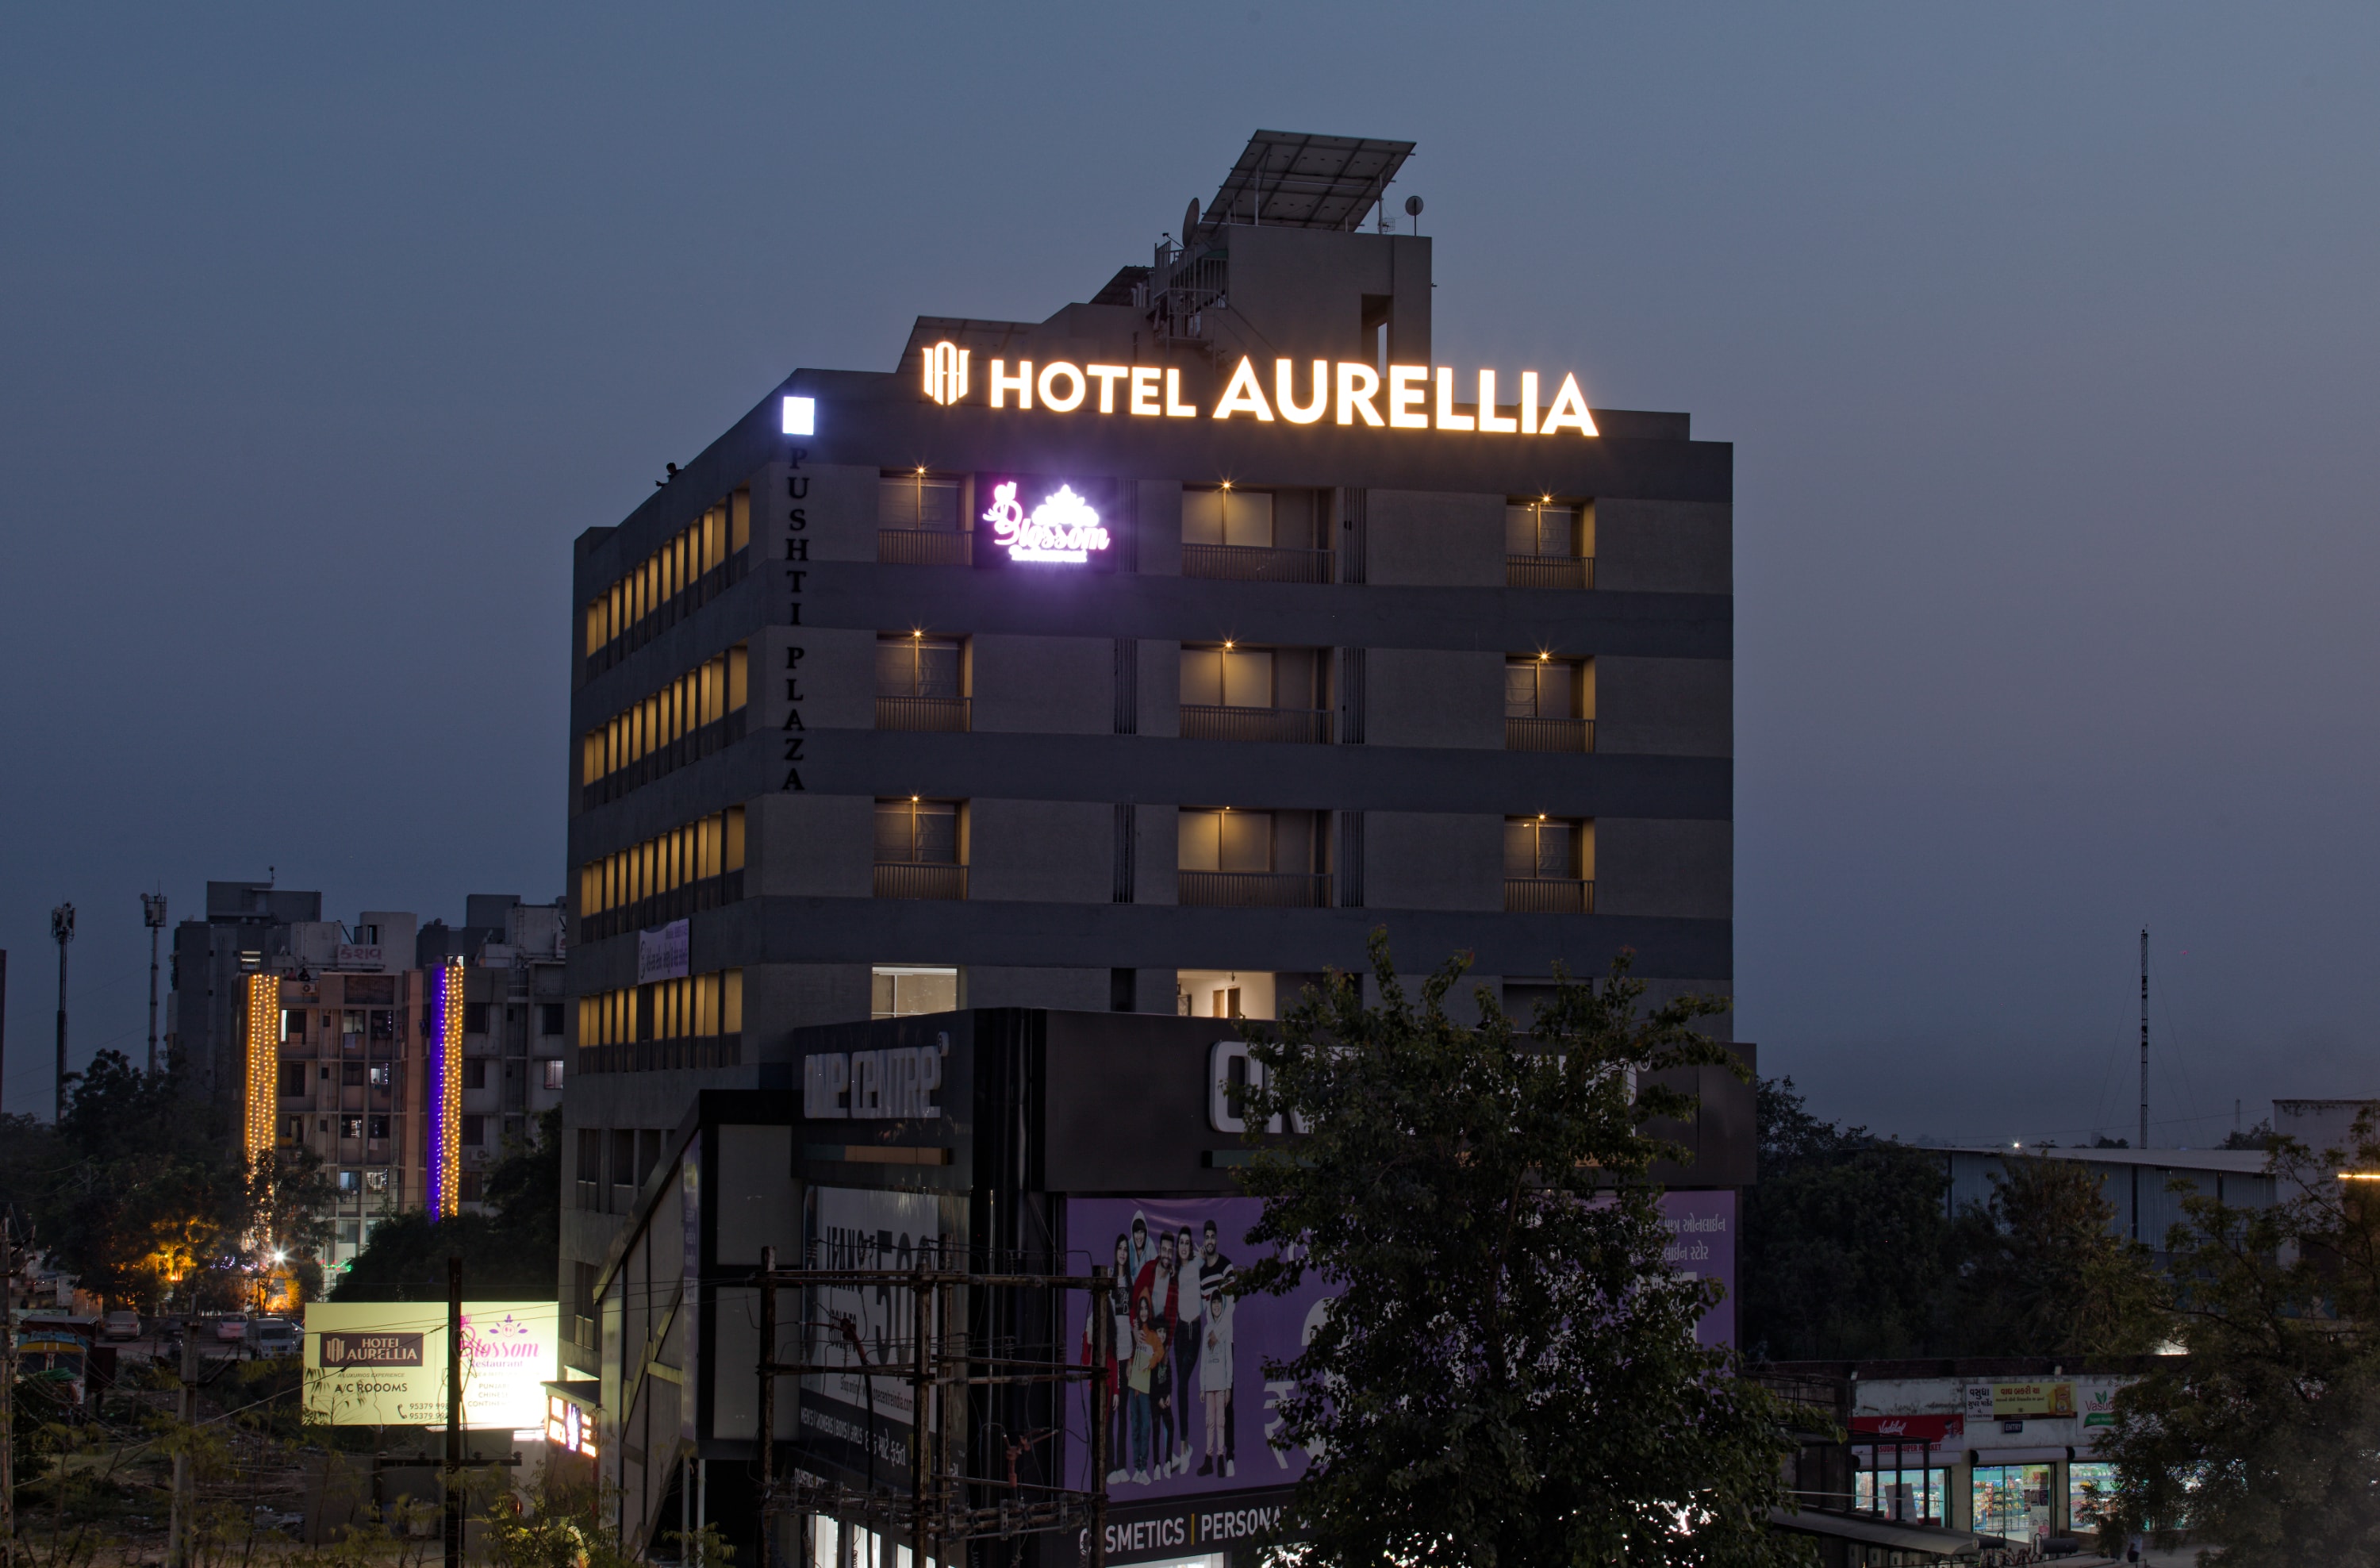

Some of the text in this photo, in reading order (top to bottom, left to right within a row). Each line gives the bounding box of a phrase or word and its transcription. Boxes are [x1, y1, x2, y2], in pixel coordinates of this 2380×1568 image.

[990, 353, 1600, 437] HOTEL AURELLIA
[982, 481, 1111, 551] Blossom
[781, 447, 810, 791] PUSHTI PLAZA
[804, 1052, 850, 1120] ONE
[1690, 1239, 1710, 1260] સ્ટોર
[346, 1338, 418, 1360] HOTEL AURELLIA
[2085, 1400, 2115, 1412] Vasud
[836, 1419, 847, 1439] BOYS
[2005, 1423, 2022, 1432] ENTRY
[1079, 1516, 1186, 1556] CSMETICS
[1200, 1505, 1287, 1542] PERSONA
